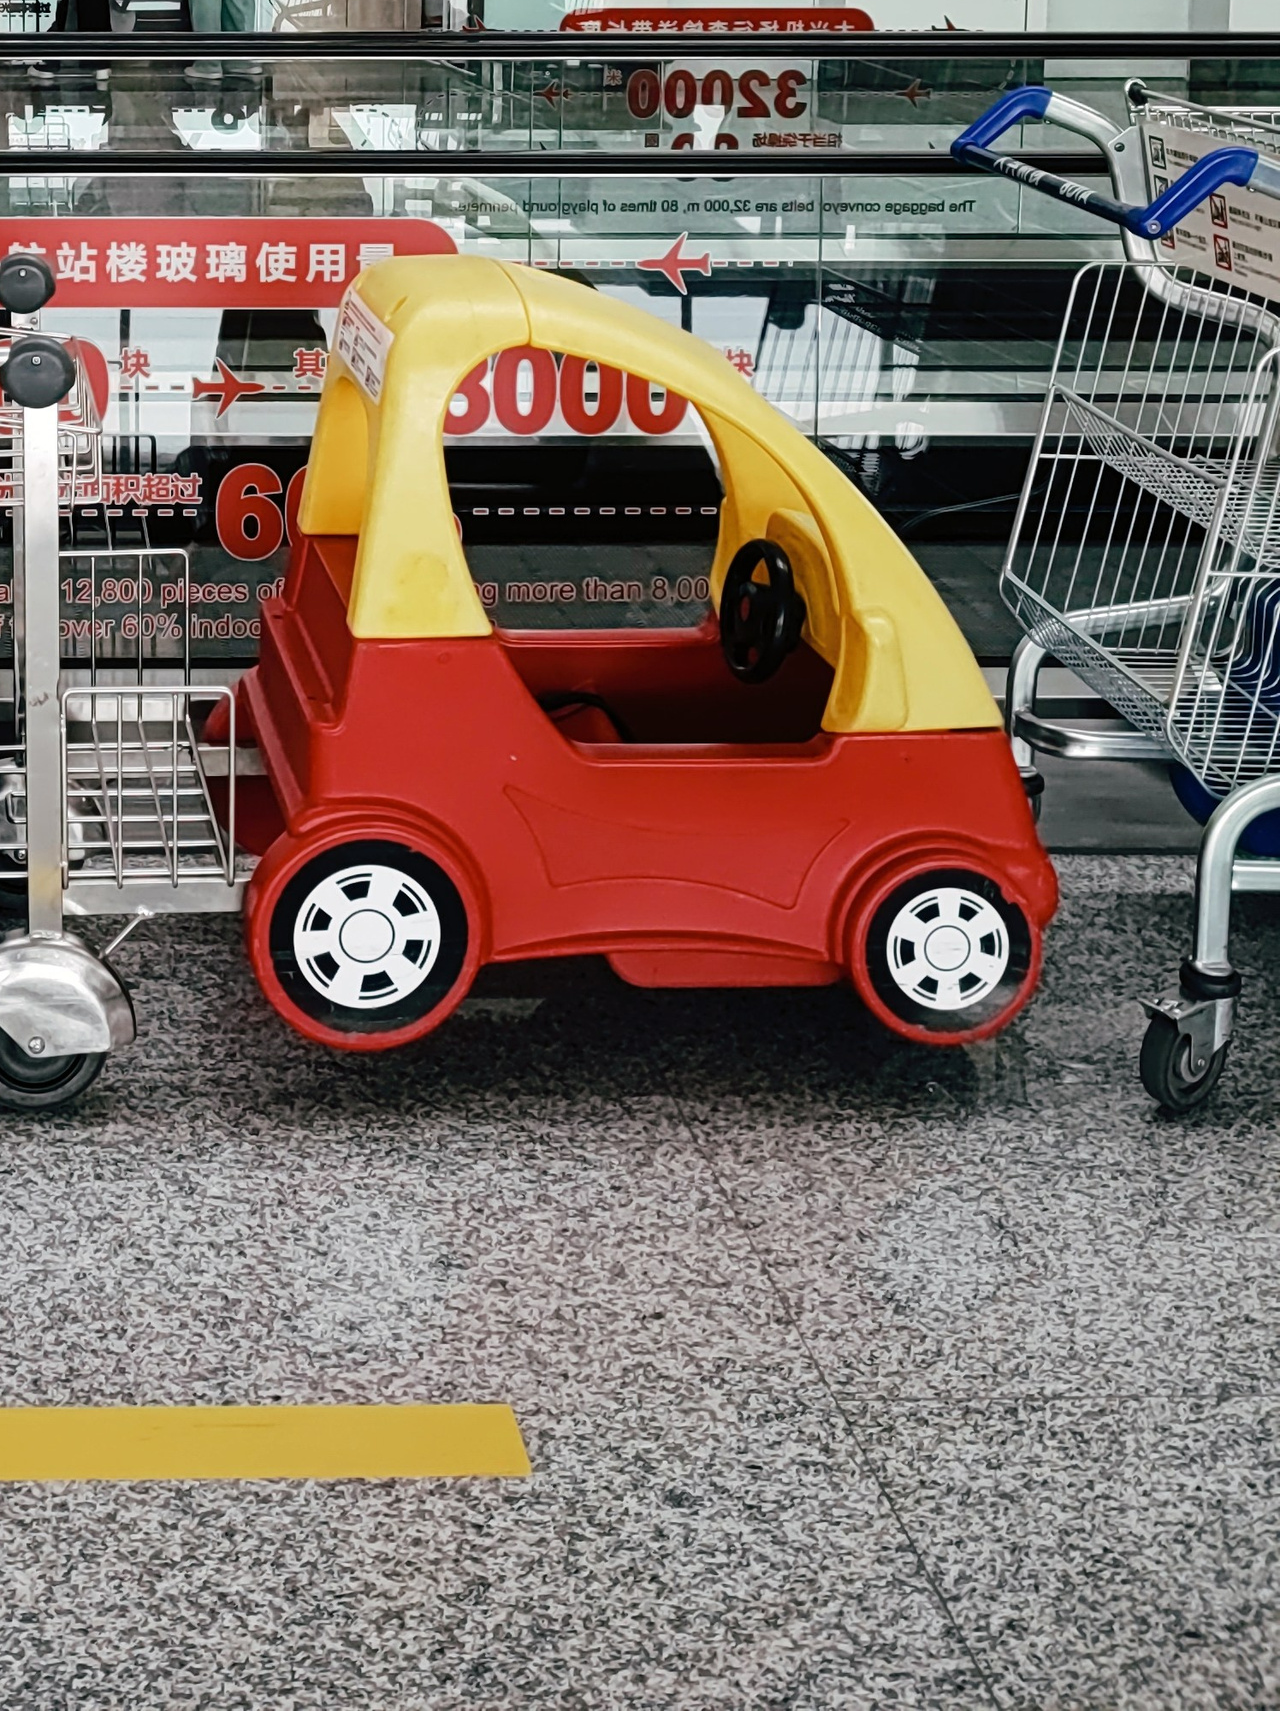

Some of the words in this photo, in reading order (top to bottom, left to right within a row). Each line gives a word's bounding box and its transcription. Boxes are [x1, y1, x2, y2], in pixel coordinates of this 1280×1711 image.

[120, 346, 151, 379] 块
[293, 347, 329, 379] 其
[215, 463, 308, 561] 6
[61, 578, 153, 605] 12,800
[161, 578, 249, 608] pieces
[256, 577, 285, 602] of
[506, 581, 576, 602] more
[584, 577, 642, 602] than
[651, 577, 710, 604] 8,00
[59, 620, 114, 639] over
[122, 614, 182, 639] 60%
[191, 613, 261, 639] indoo
